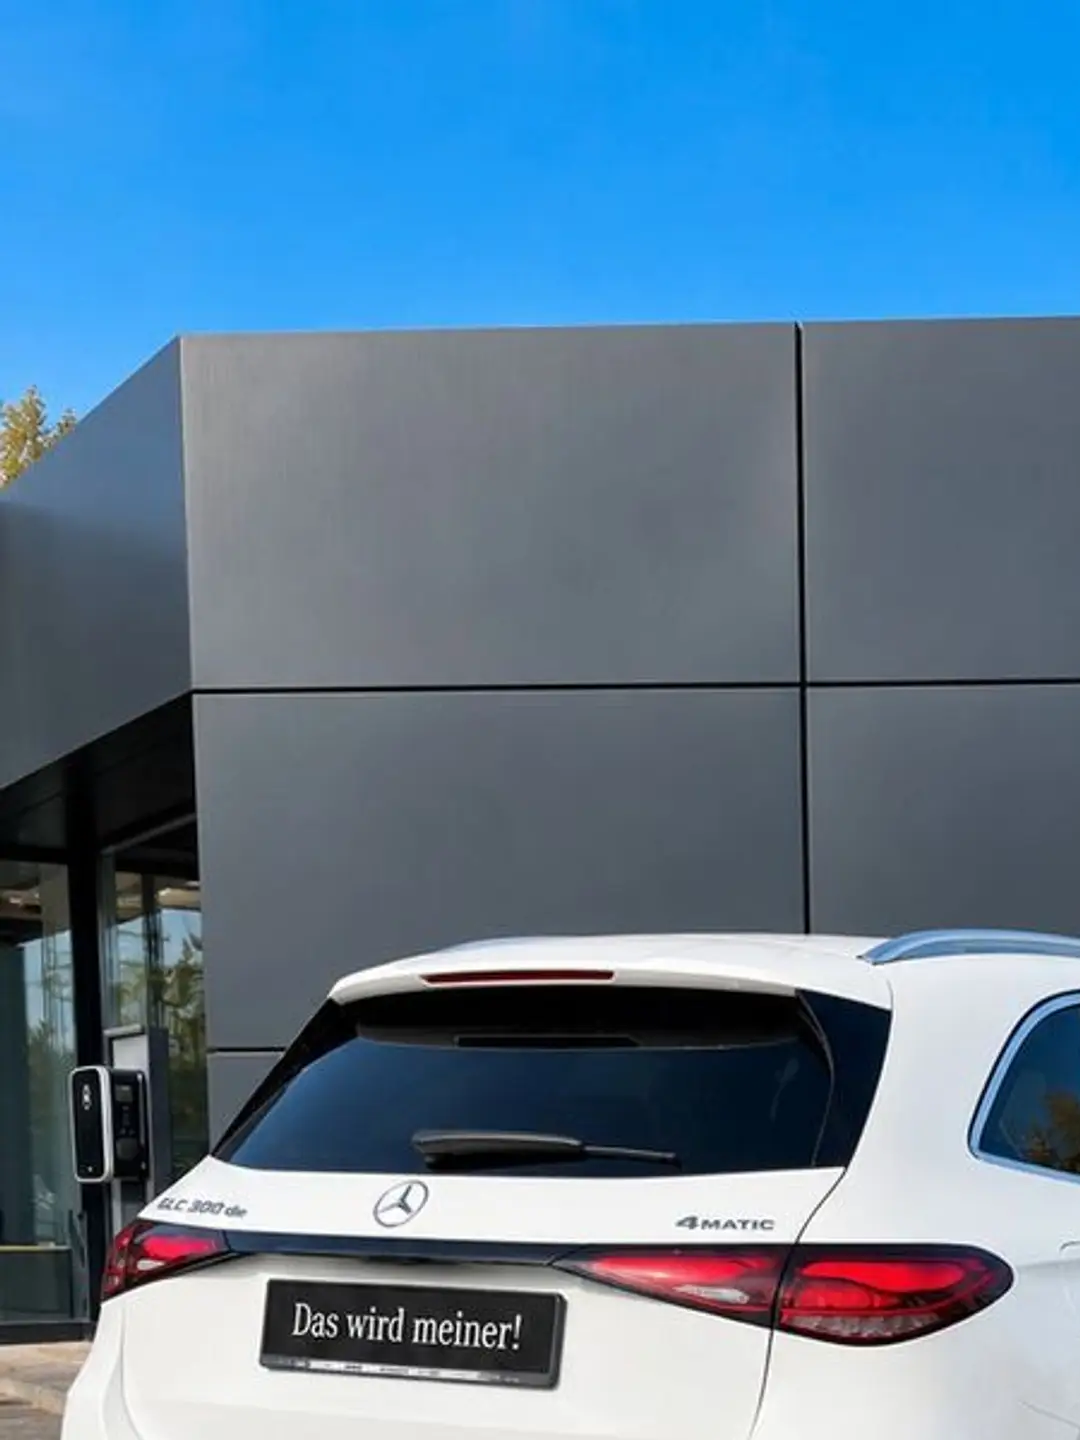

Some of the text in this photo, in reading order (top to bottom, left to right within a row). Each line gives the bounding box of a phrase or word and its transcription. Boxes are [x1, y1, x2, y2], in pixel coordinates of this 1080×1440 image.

[187, 1199, 225, 1215] 300
[674, 1215, 775, 1231] 4MATIC
[291, 1302, 522, 1351] Das wird meiner!
